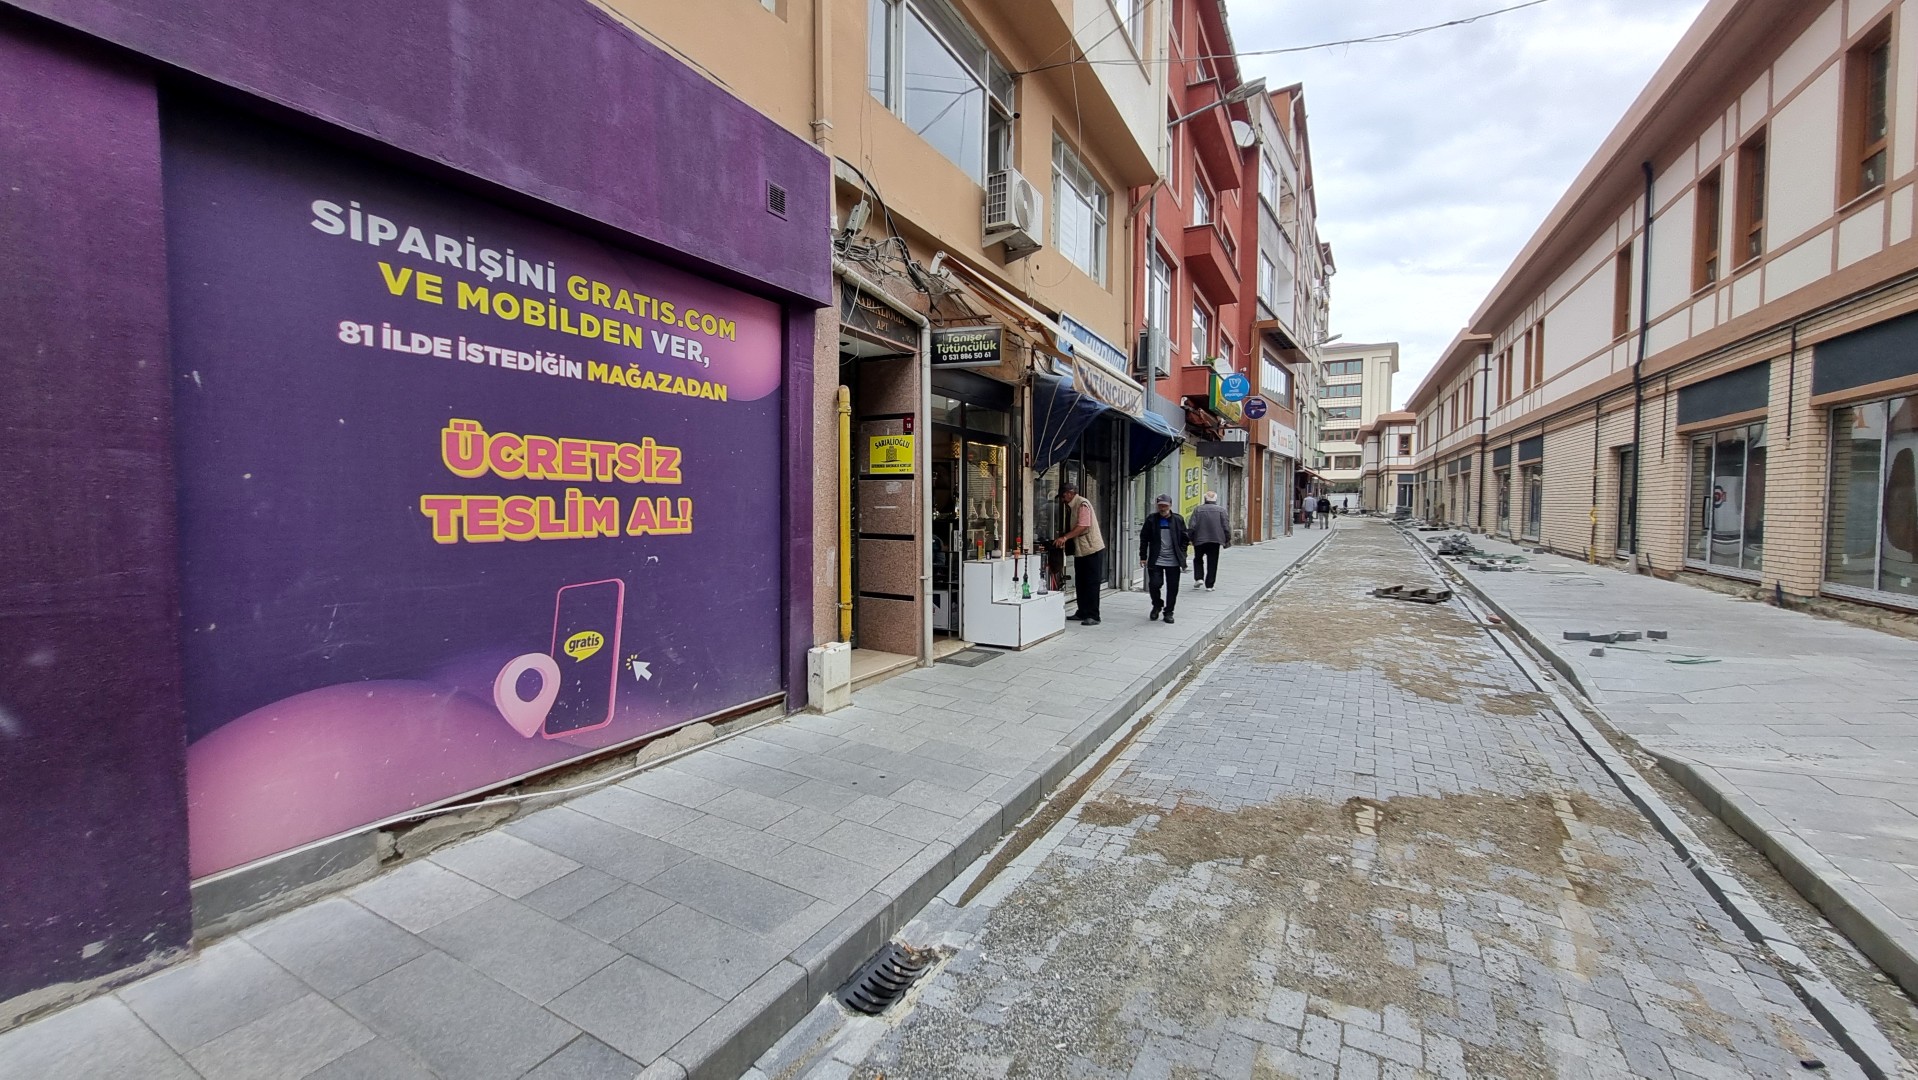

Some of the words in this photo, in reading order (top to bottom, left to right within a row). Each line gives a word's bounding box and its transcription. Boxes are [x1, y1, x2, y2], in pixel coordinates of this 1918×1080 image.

[311, 199, 556, 294] SİPARİŞİNİ
[566, 275, 737, 341] GRATIS.COM
[378, 261, 443, 305] VE
[457, 280, 643, 350] MOBİLDEN
[651, 329, 711, 368] VER,
[338, 320, 374, 348] 81
[382, 322, 452, 359] İLDE
[458, 335, 583, 380] İSTEDİĞİN
[587, 360, 728, 402] MAĞAZADAN
[936, 340, 997, 354] Tütüncülük
[960, 352, 973, 360] 886
[973, 351, 983, 359] 50
[441, 418, 682, 484] ÜCRETSİZ
[420, 488, 619, 544] TESLİM
[626, 496, 693, 537] AL!
[568, 634, 600, 653] gratis
